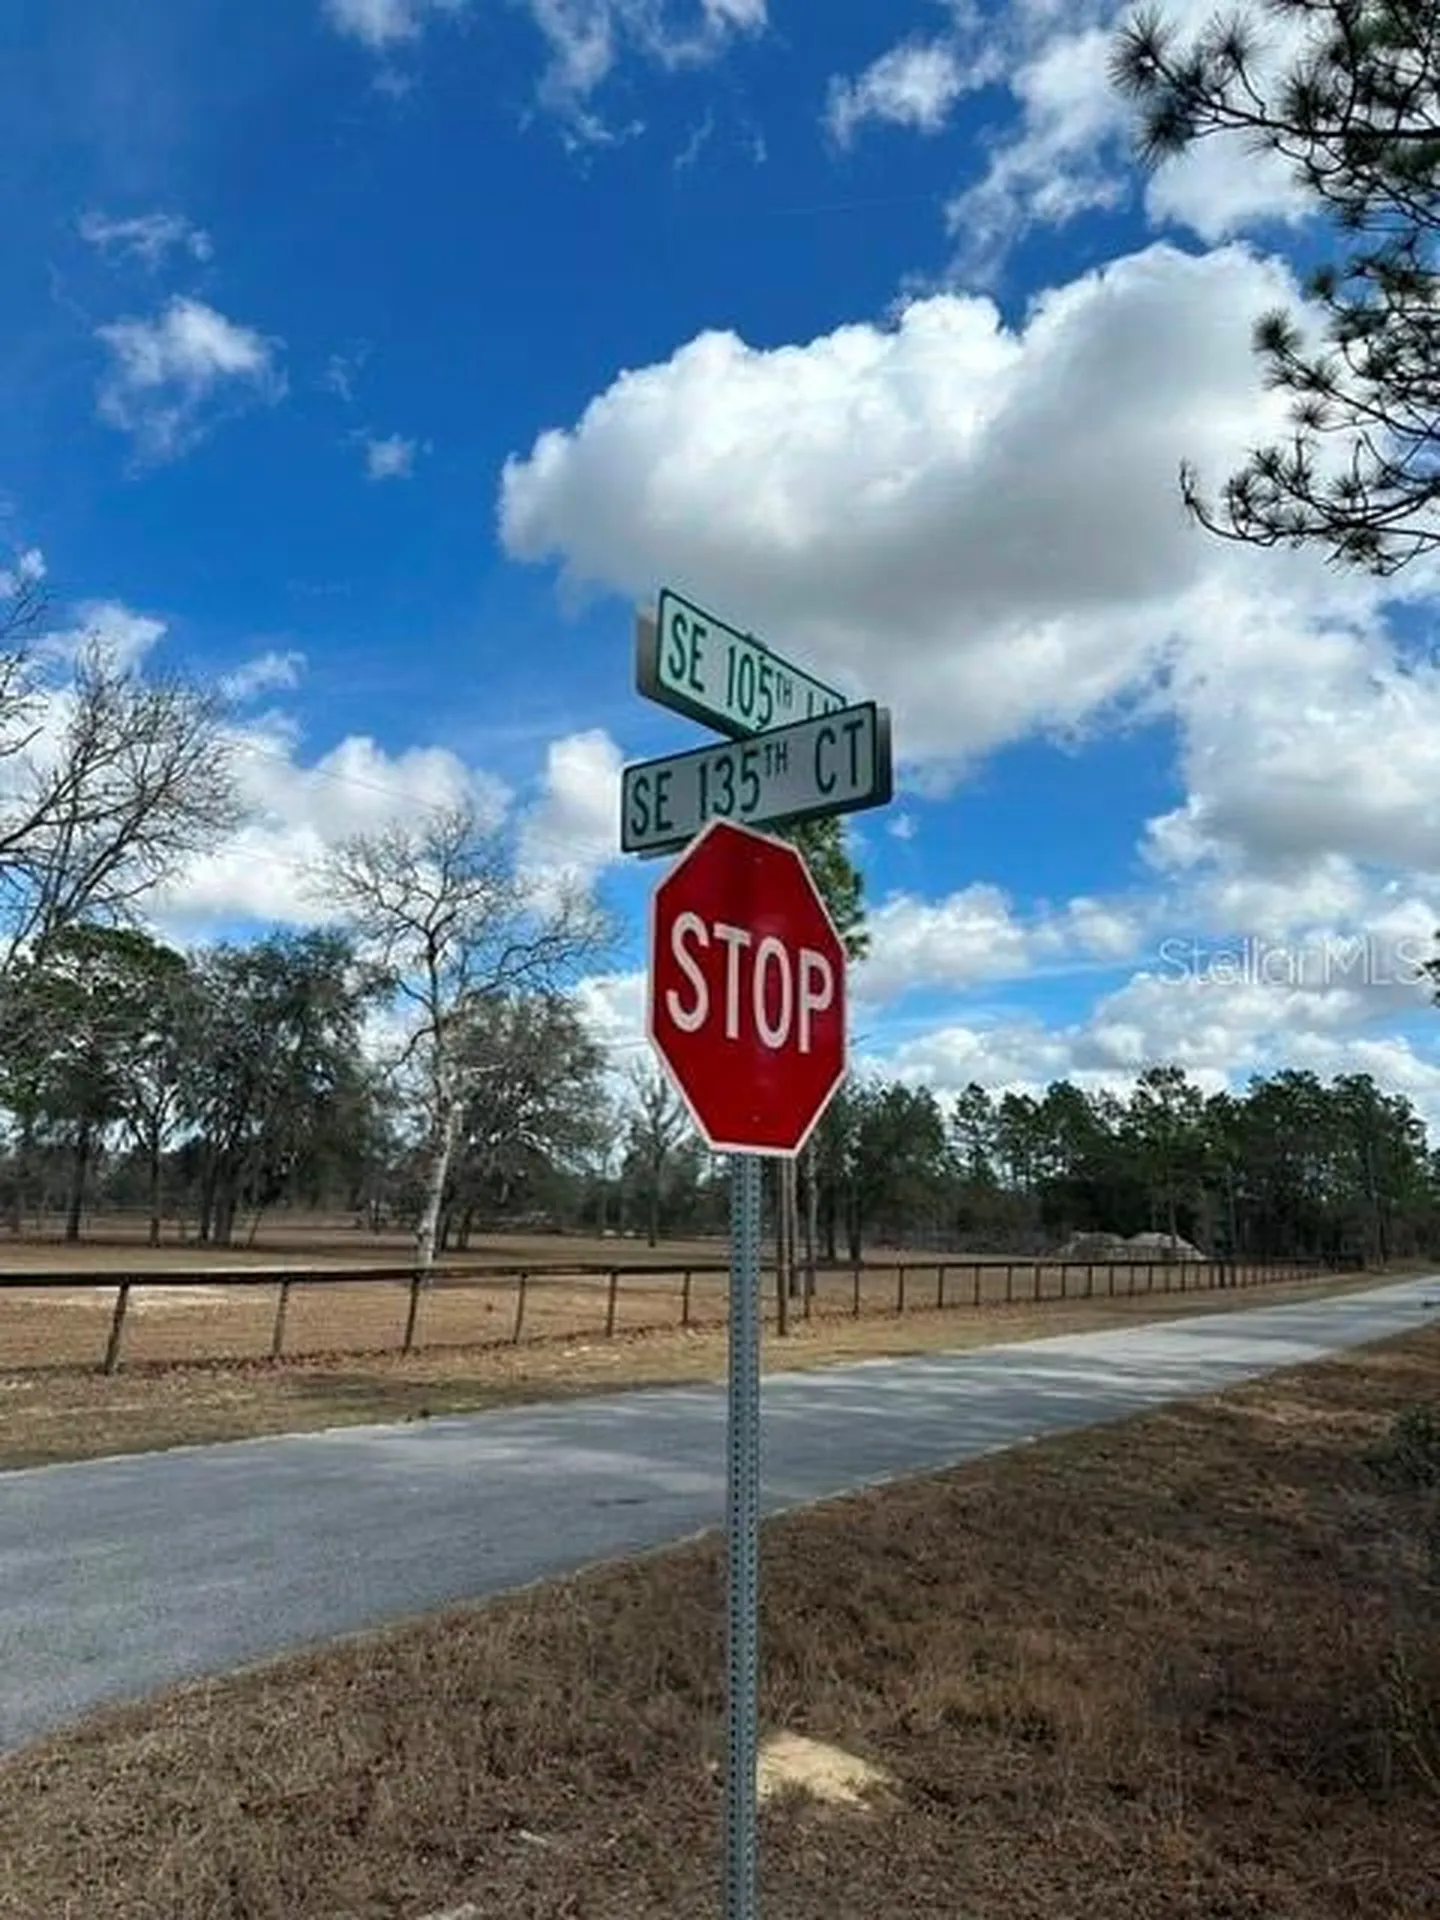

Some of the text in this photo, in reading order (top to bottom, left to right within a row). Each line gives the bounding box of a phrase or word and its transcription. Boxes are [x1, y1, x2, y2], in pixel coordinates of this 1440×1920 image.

[668, 612, 706, 693] SE
[631, 770, 673, 837] SE
[815, 719, 865, 794] CT
[666, 911, 833, 1054] STOP
